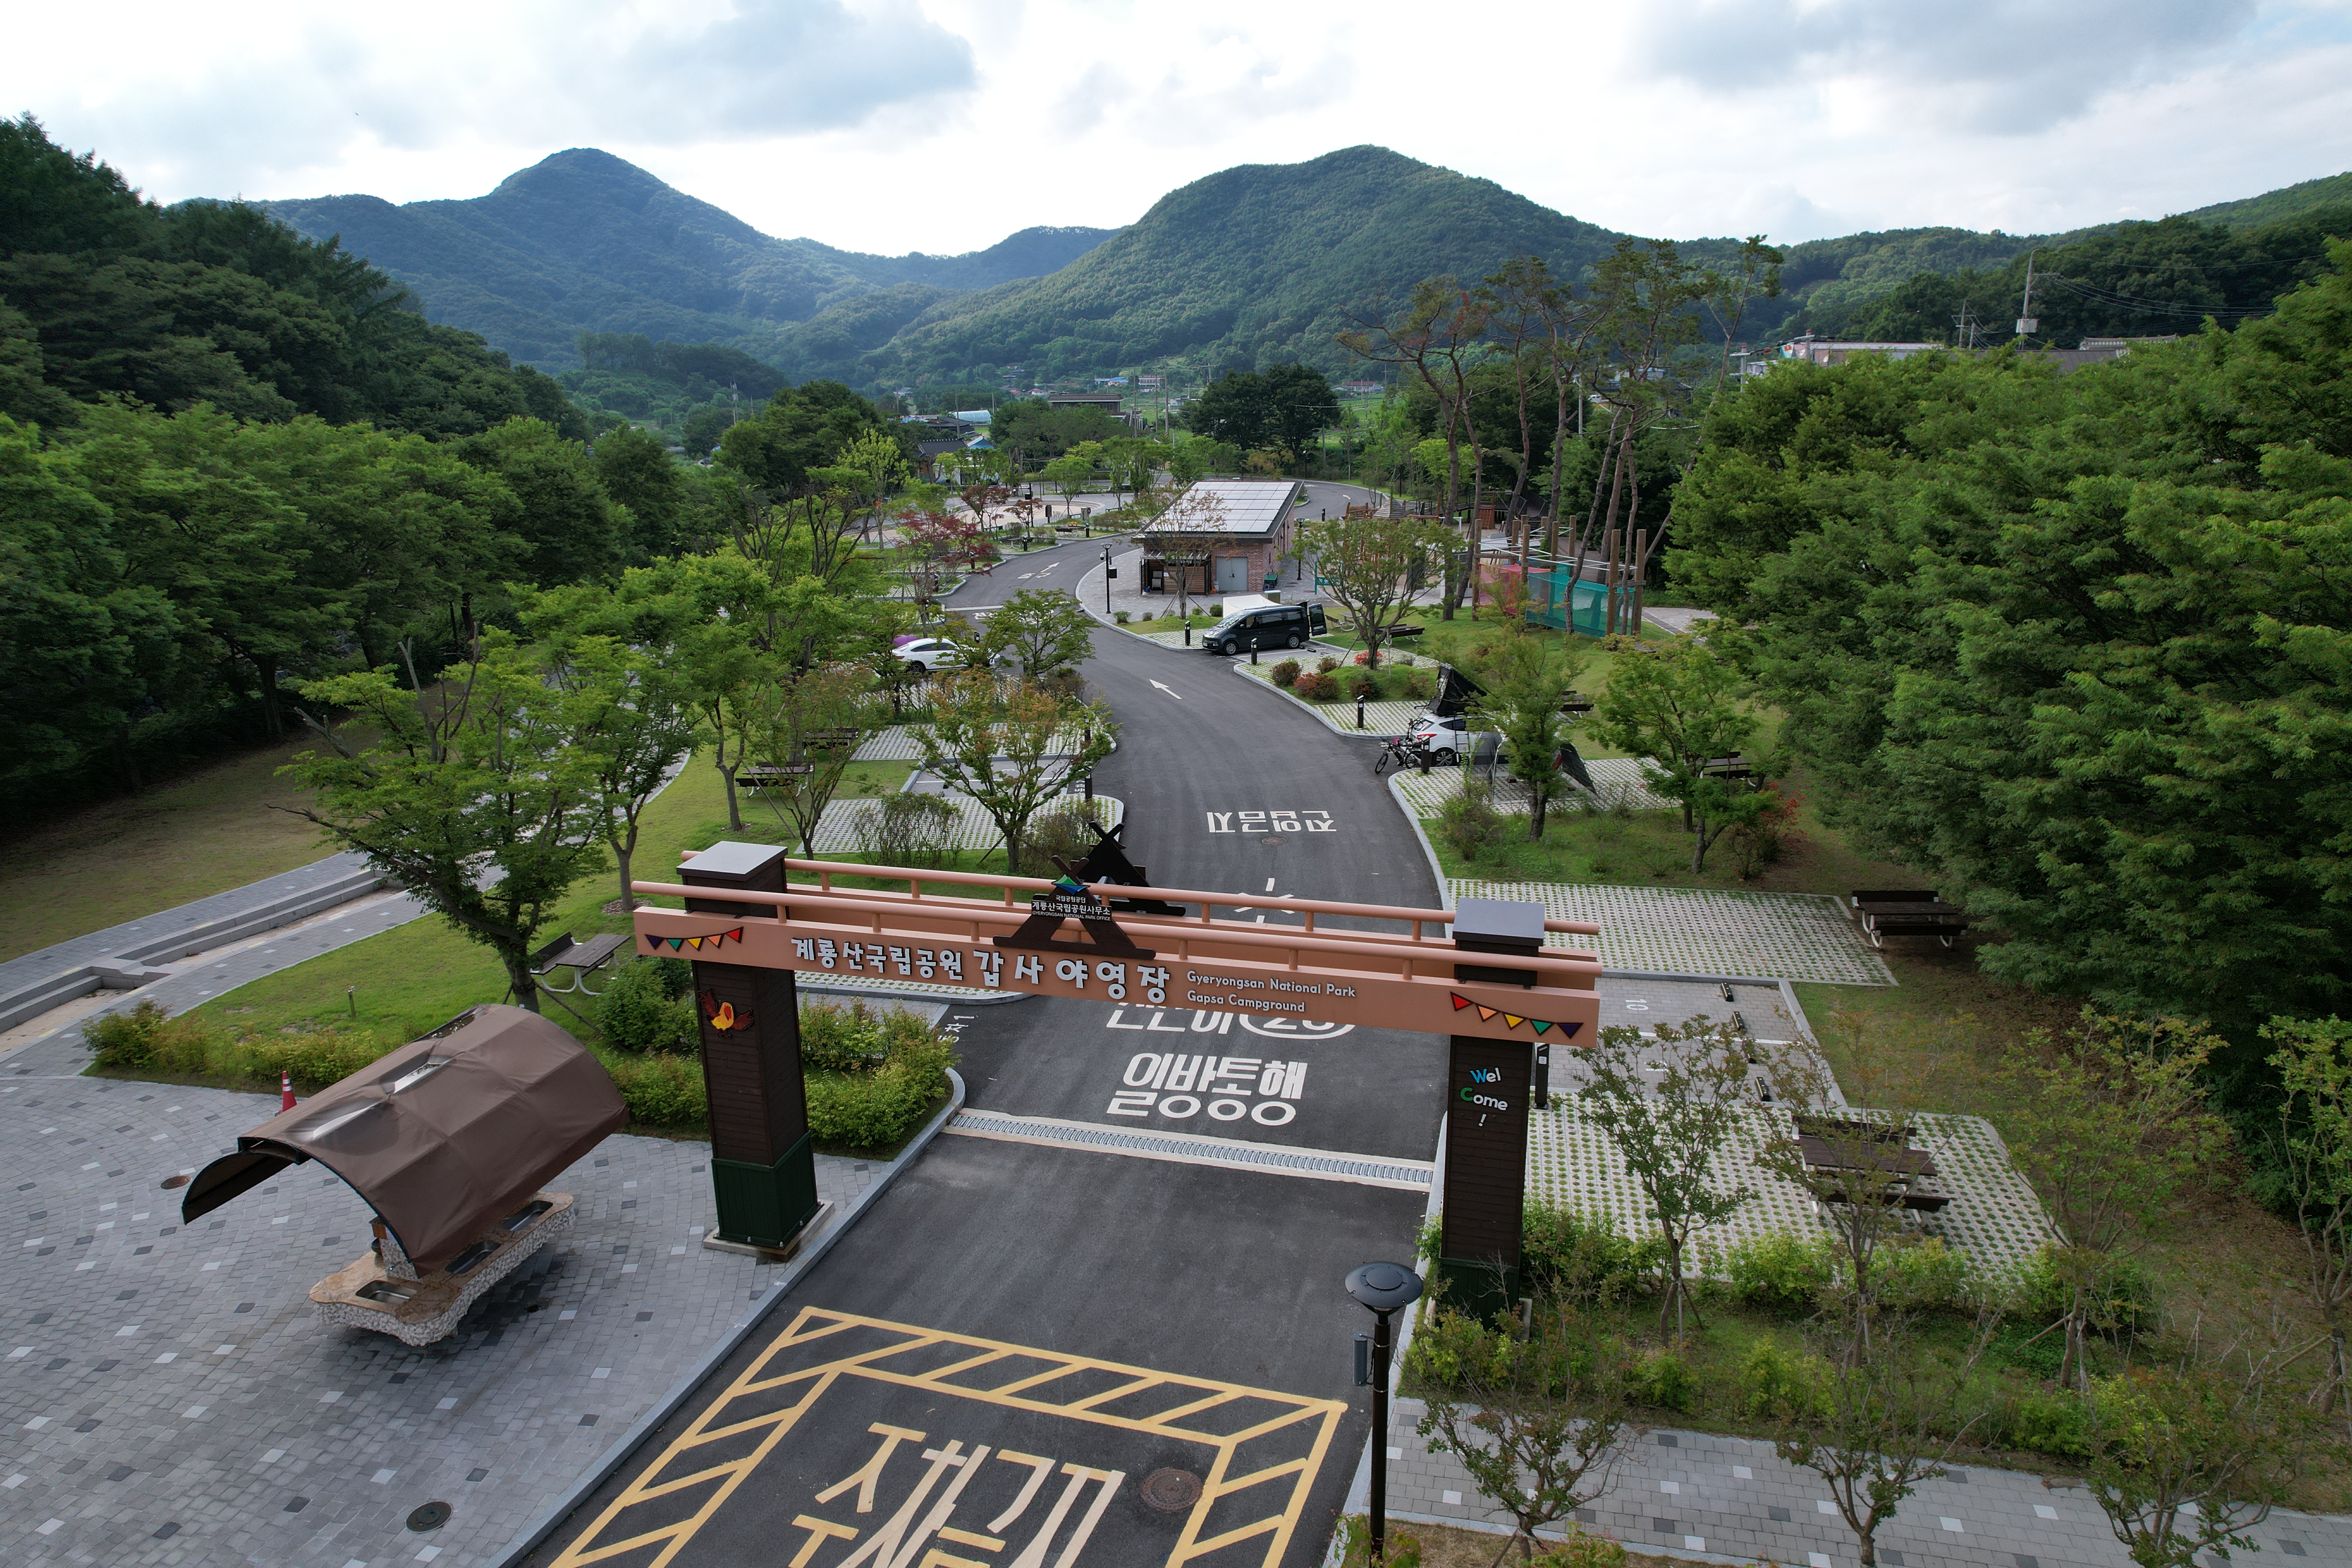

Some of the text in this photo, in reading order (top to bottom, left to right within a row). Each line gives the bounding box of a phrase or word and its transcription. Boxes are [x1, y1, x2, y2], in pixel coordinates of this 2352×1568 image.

[1206, 811, 1337, 833] 진입금지
[1032, 901, 1111, 915] 계룡산국립공원사무소
[1056, 895, 1086, 903] 국립공원공단
[791, 938, 1170, 1004] 계룡산국립공원 갑사야영장
[1187, 971, 1356, 997] Gyeryongsan National Park
[1187, 990, 1305, 1012] Gapsa Campground
[1470, 1067, 1501, 1084] Wel
[1106, 1053, 1308, 1126] 일방통행
[1460, 1087, 1508, 1111] Come
